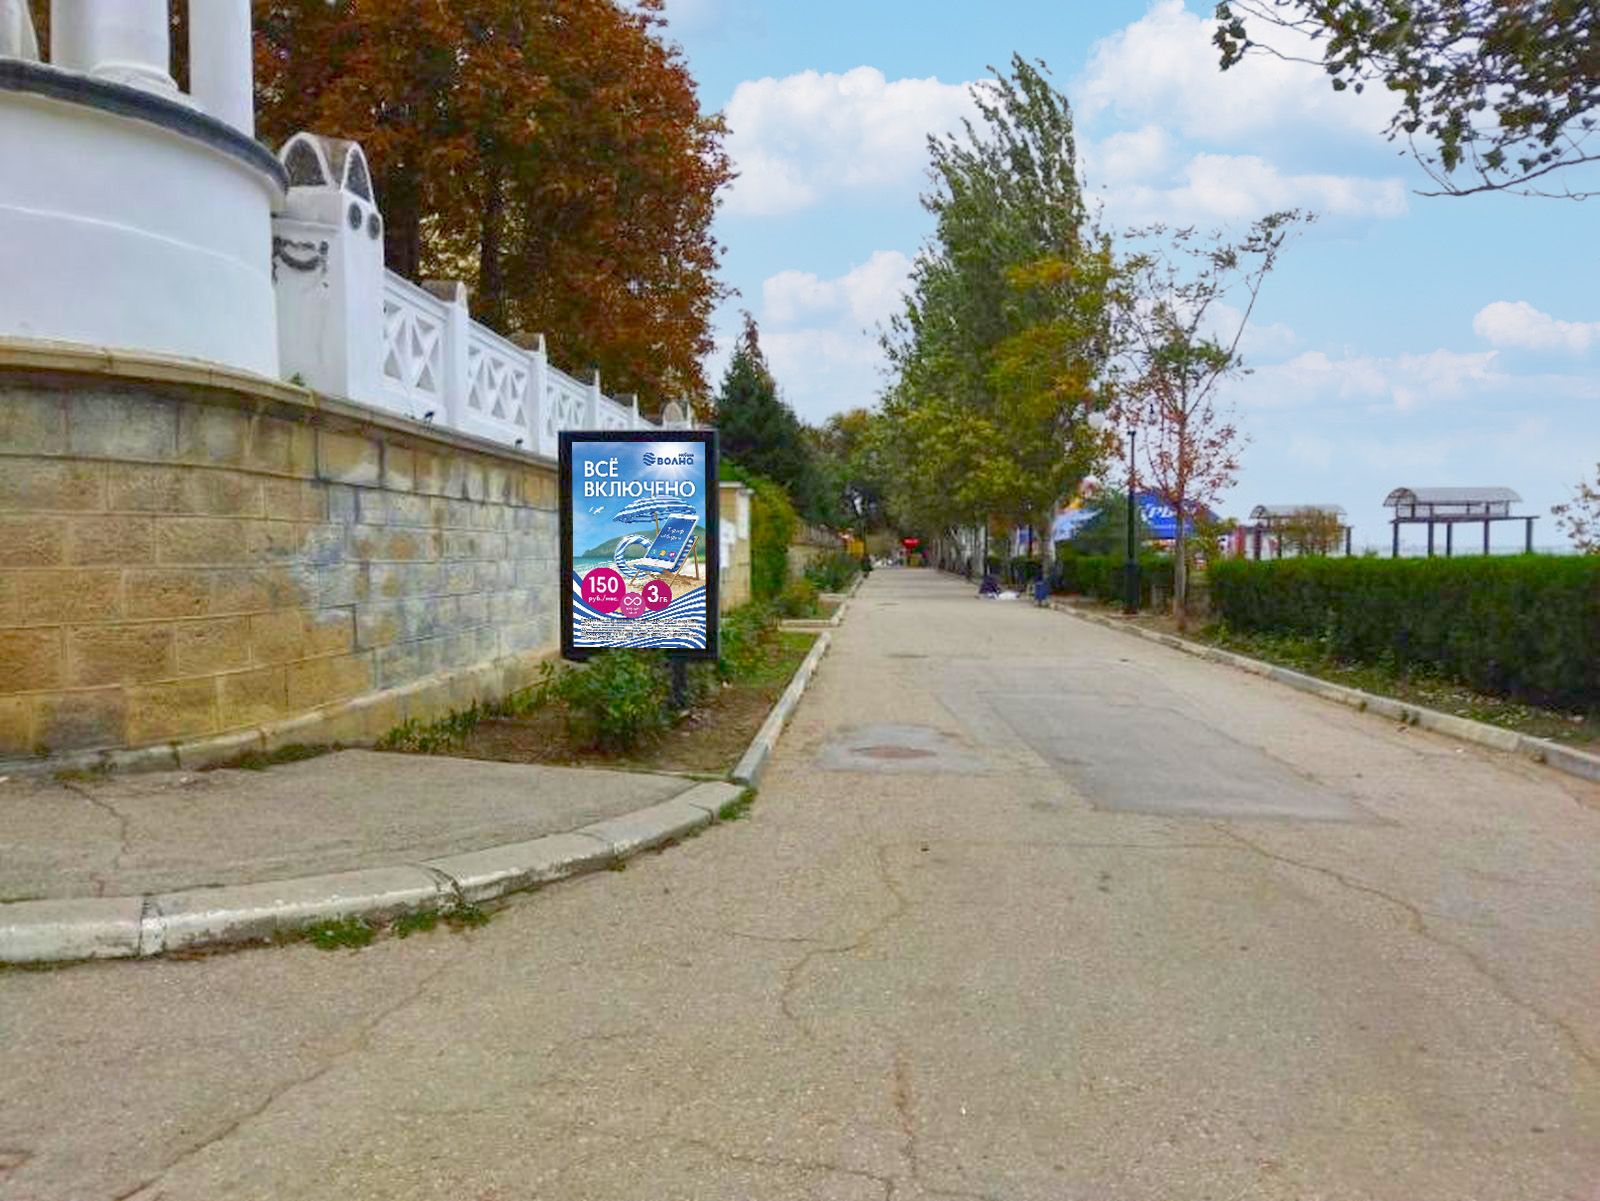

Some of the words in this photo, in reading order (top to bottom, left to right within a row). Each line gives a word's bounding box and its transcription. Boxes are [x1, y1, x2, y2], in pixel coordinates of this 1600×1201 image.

[584, 457, 619, 477] ВСЁ
[584, 481, 696, 498] ВКЛЮЧЕНО
[588, 576, 619, 593] 150
